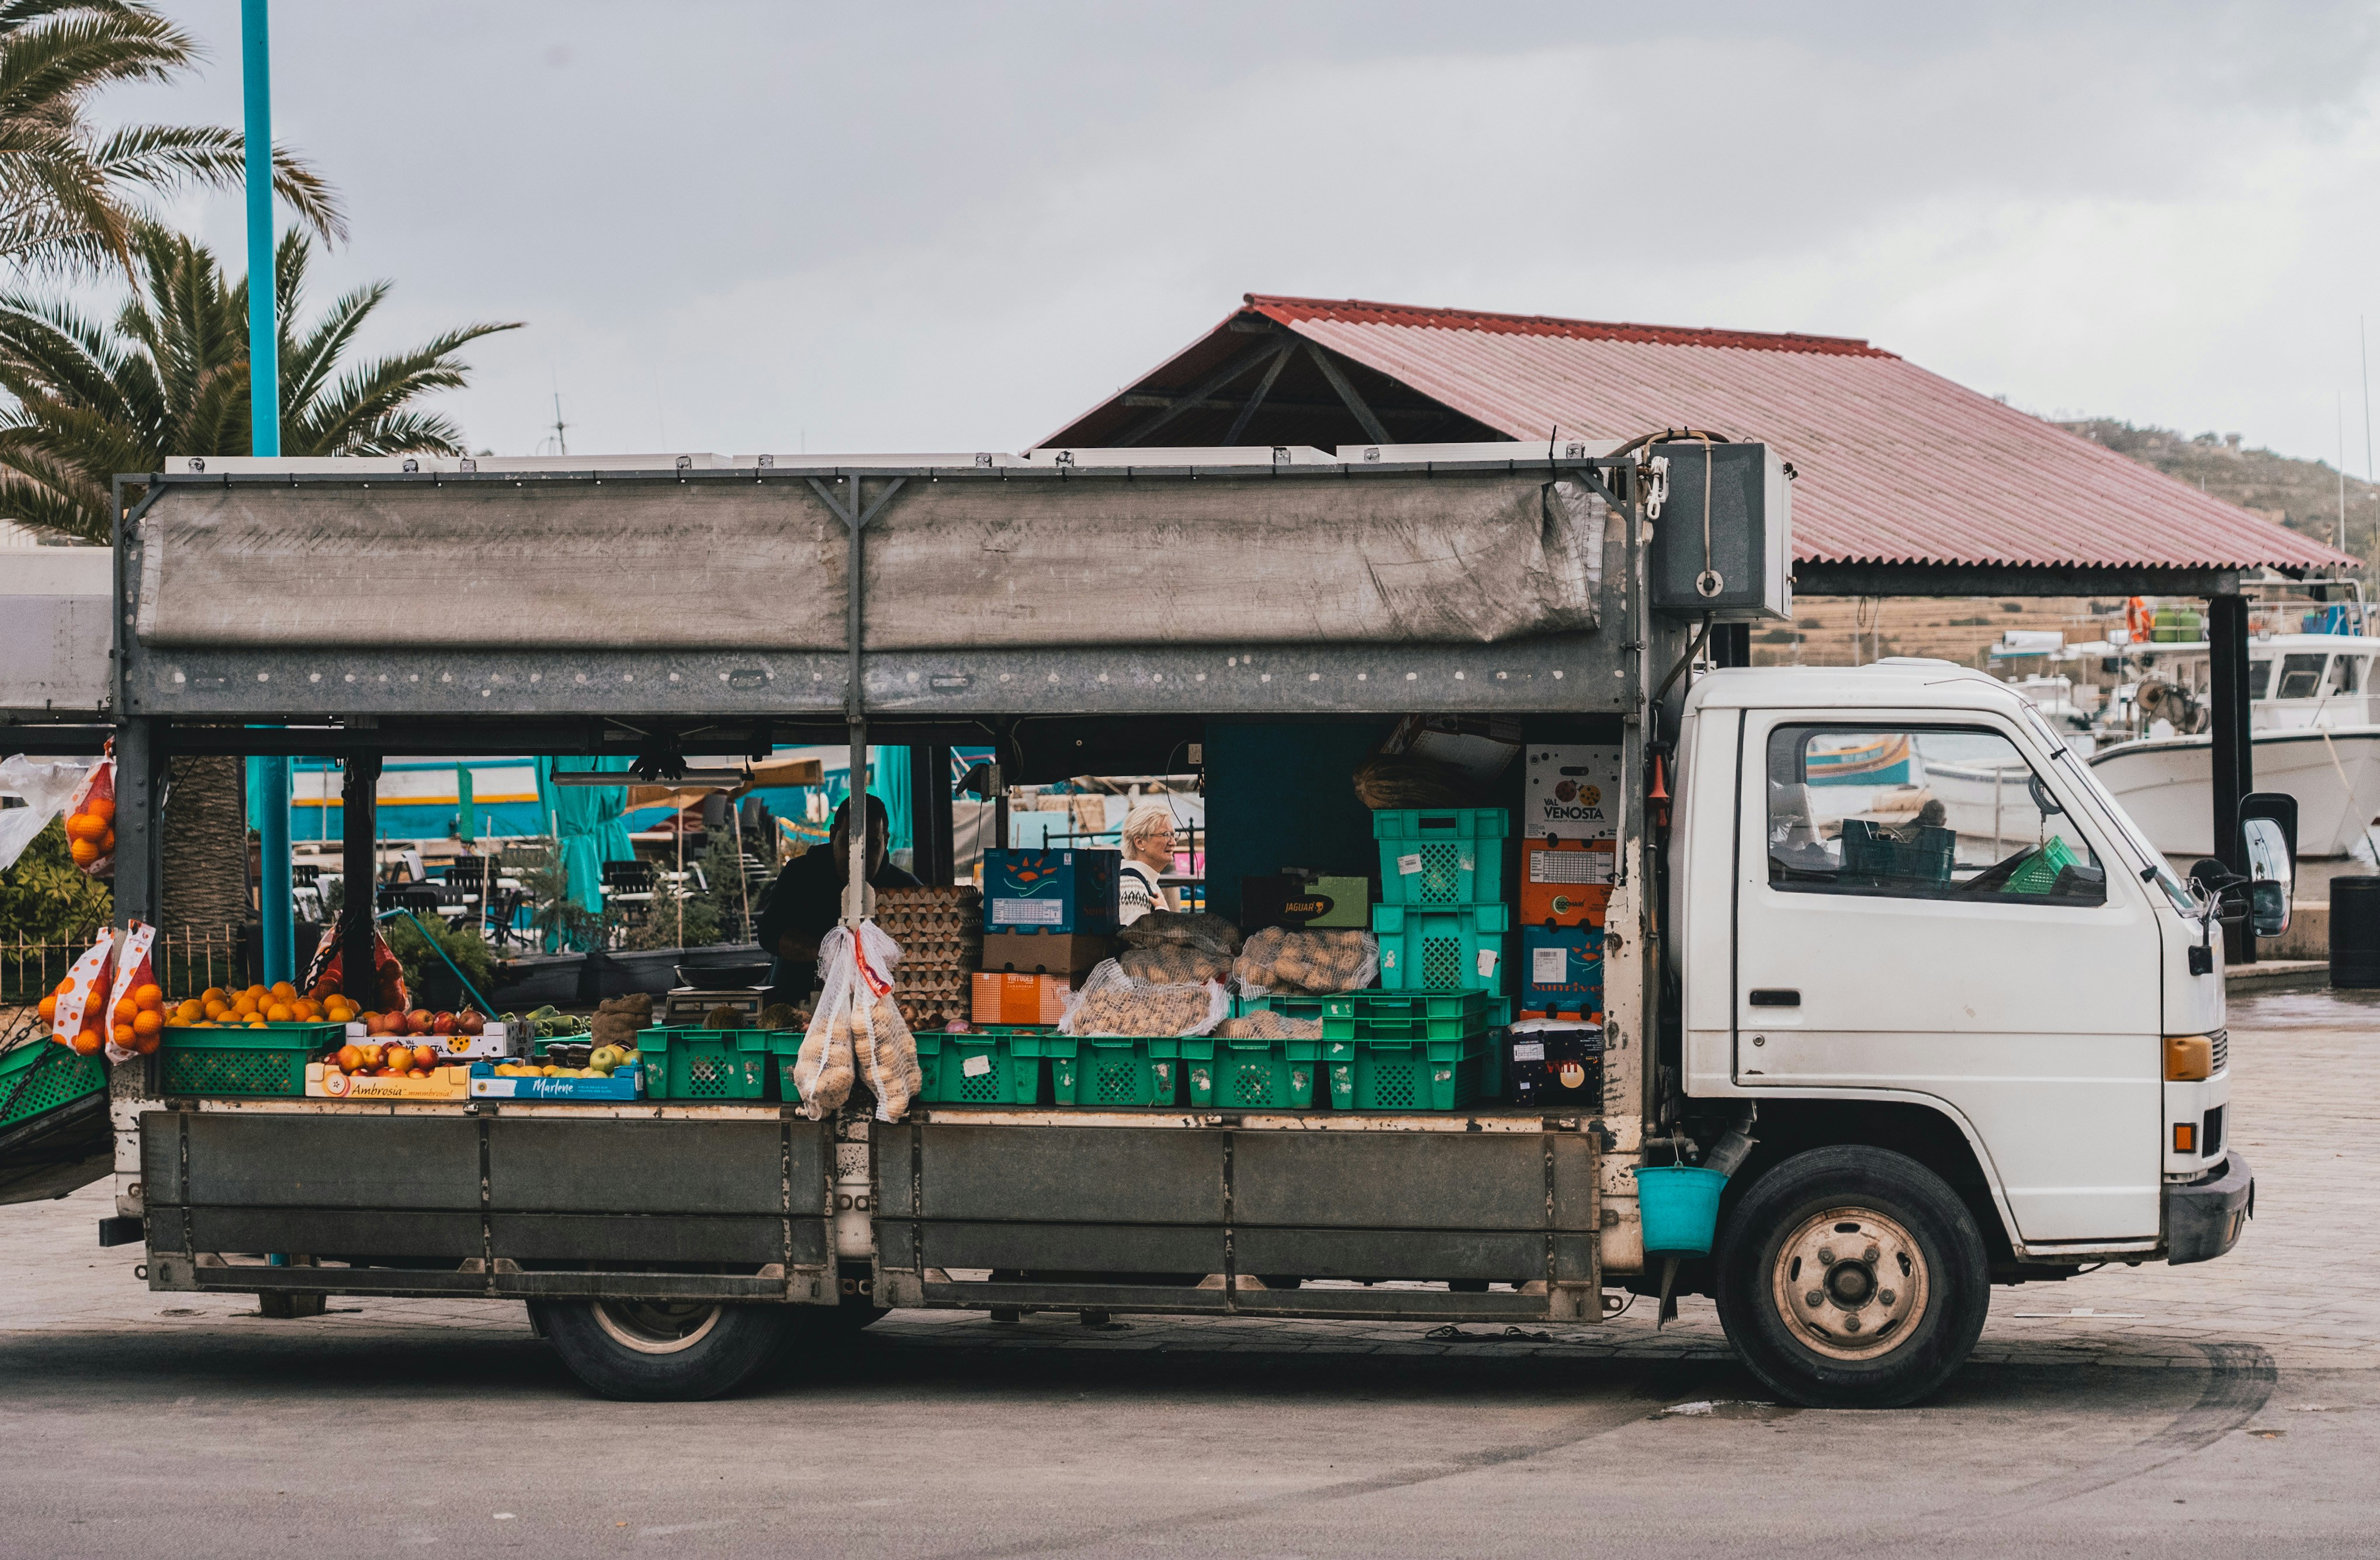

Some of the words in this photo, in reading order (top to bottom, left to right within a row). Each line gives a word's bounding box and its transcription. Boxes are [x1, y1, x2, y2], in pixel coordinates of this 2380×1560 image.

[1544, 798, 1558, 806] VAL
[1543, 806, 1605, 820] VENOSTA
[1285, 903, 1314, 913] JAGUAR
[1530, 982, 1601, 992] Sunrive
[351, 1083, 403, 1096] Ambrosia
[532, 1078, 574, 1098] Marlene
